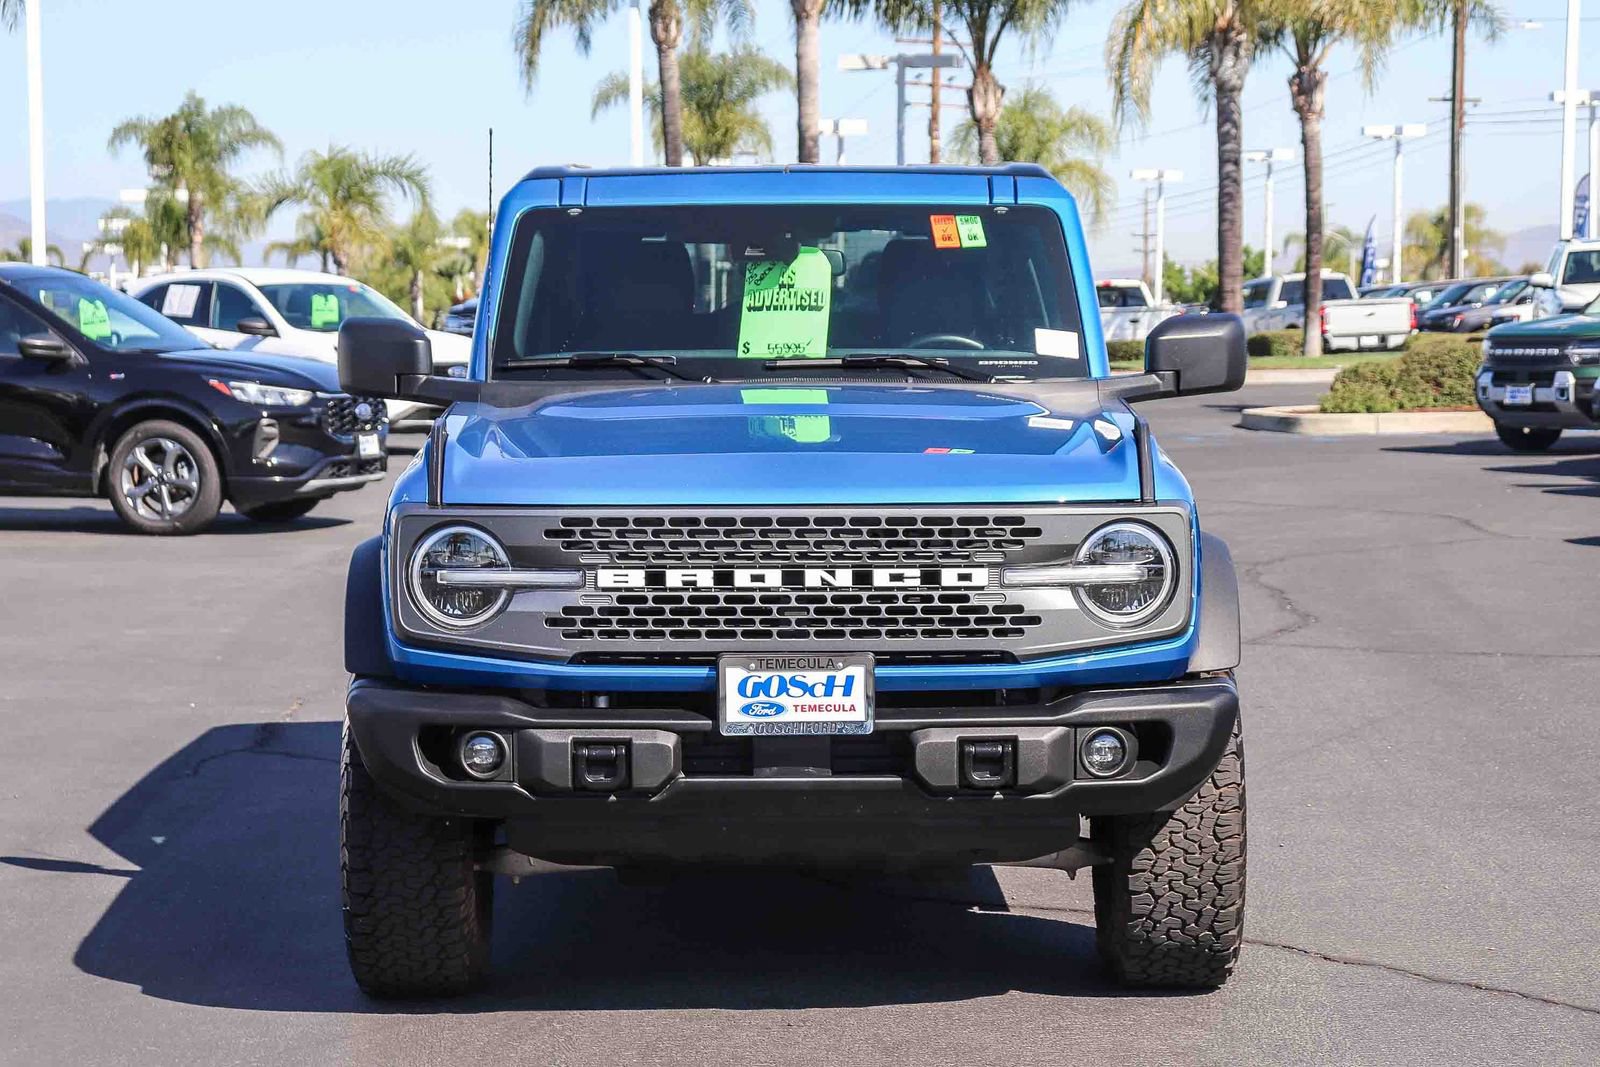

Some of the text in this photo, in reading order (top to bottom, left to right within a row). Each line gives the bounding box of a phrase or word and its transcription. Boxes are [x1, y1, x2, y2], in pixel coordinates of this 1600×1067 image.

[941, 233, 954, 242] OK
[967, 233, 979, 242] OK
[778, 267, 796, 290] AS
[746, 288, 826, 312] ADVERTISED
[742, 341, 751, 355] $
[597, 568, 989, 588] BRONCO
[757, 658, 836, 670] TEMECULA
[748, 703, 778, 716] Ford
[793, 704, 857, 713] TEMECULA
